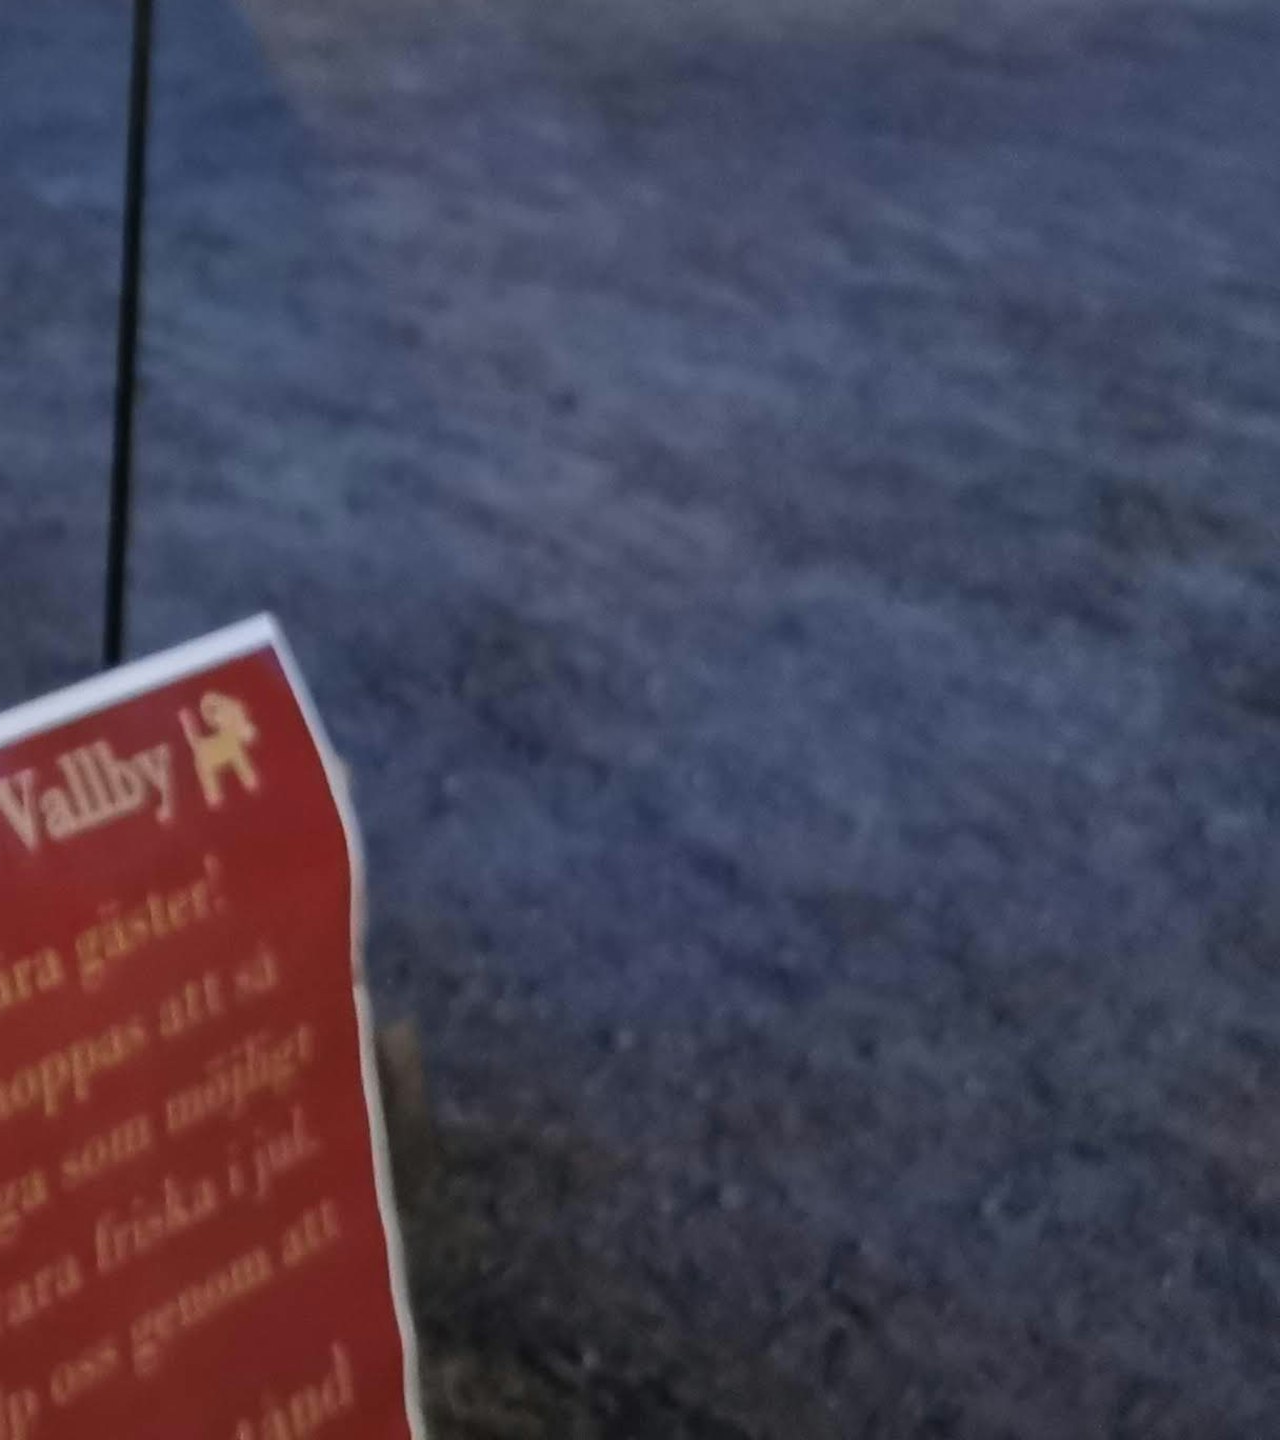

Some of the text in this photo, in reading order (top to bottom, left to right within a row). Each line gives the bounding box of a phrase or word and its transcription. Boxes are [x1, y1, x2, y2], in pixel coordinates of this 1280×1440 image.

[74, 854, 226, 994] gäster!
[159, 971, 224, 1038] att
[61, 1114, 153, 1190] som
[95, 1174, 217, 1273] friska
[228, 1142, 246, 1196] i
[131, 1246, 274, 1378] genom
[281, 1197, 340, 1266] att
